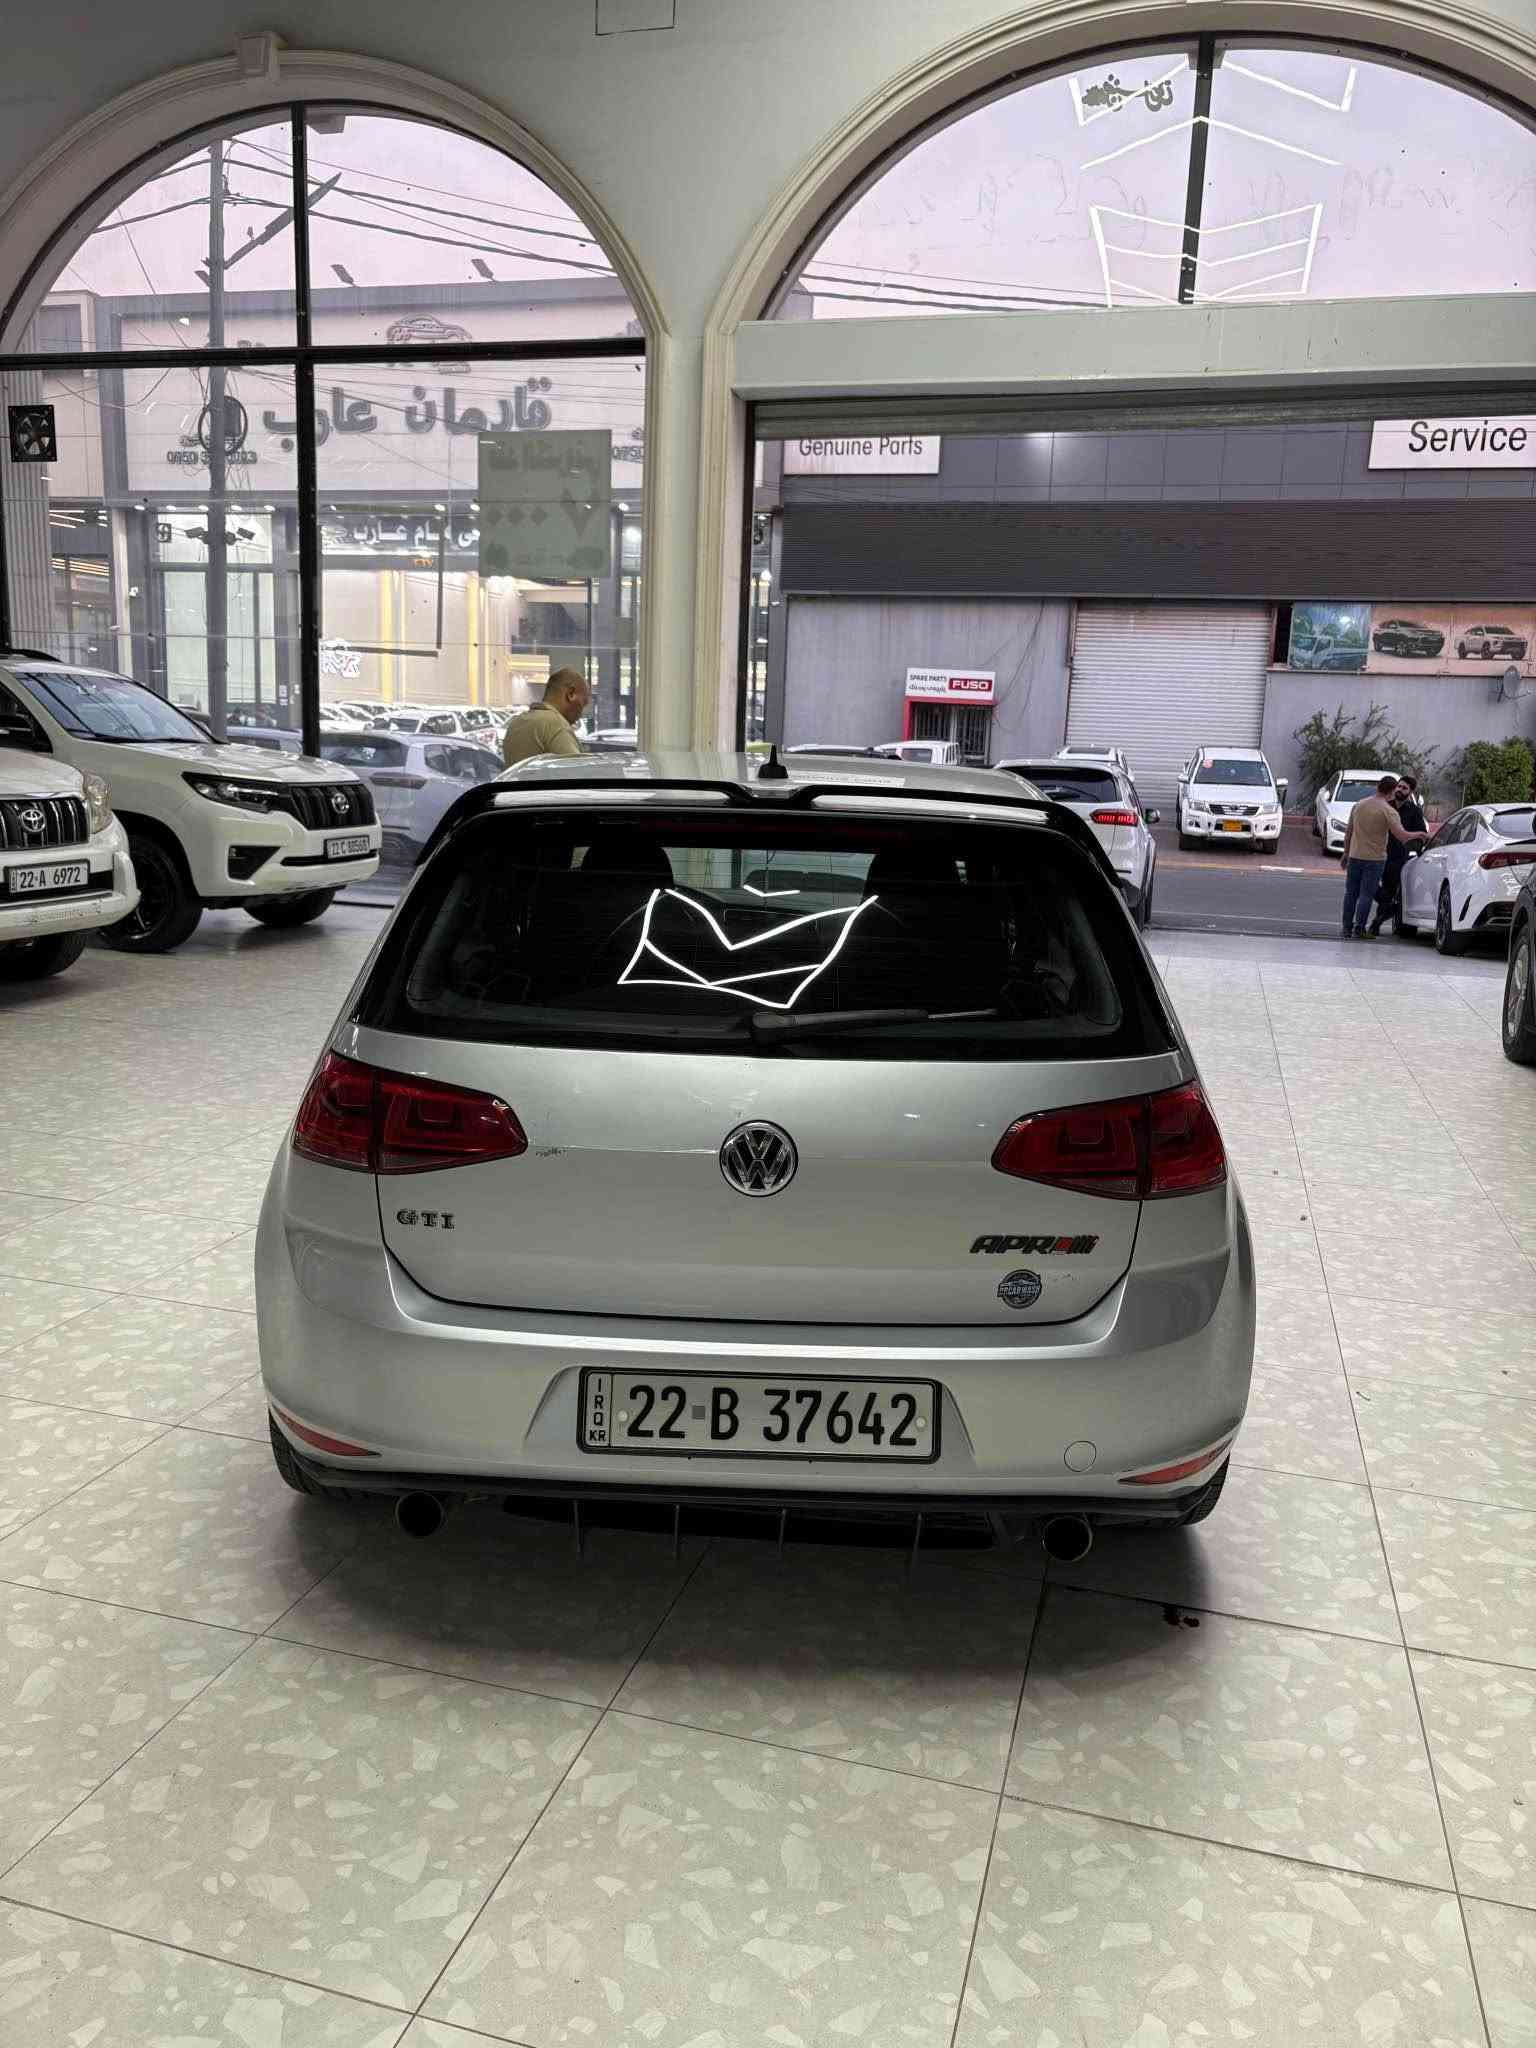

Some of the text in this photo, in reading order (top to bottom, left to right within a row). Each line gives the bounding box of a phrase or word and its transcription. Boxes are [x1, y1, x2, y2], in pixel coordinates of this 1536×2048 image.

[799, 436, 923, 457] Genuine Parts
[1408, 420, 1528, 452] Service
[952, 680, 990, 690] FUSO
[20, 871, 34, 889] 22
[39, 869, 46, 887] A
[53, 866, 81, 885] 6972
[396, 1210, 455, 1229] GTI
[627, 1384, 918, 1447] 22 B 37642
[588, 1430, 607, 1442] KR
